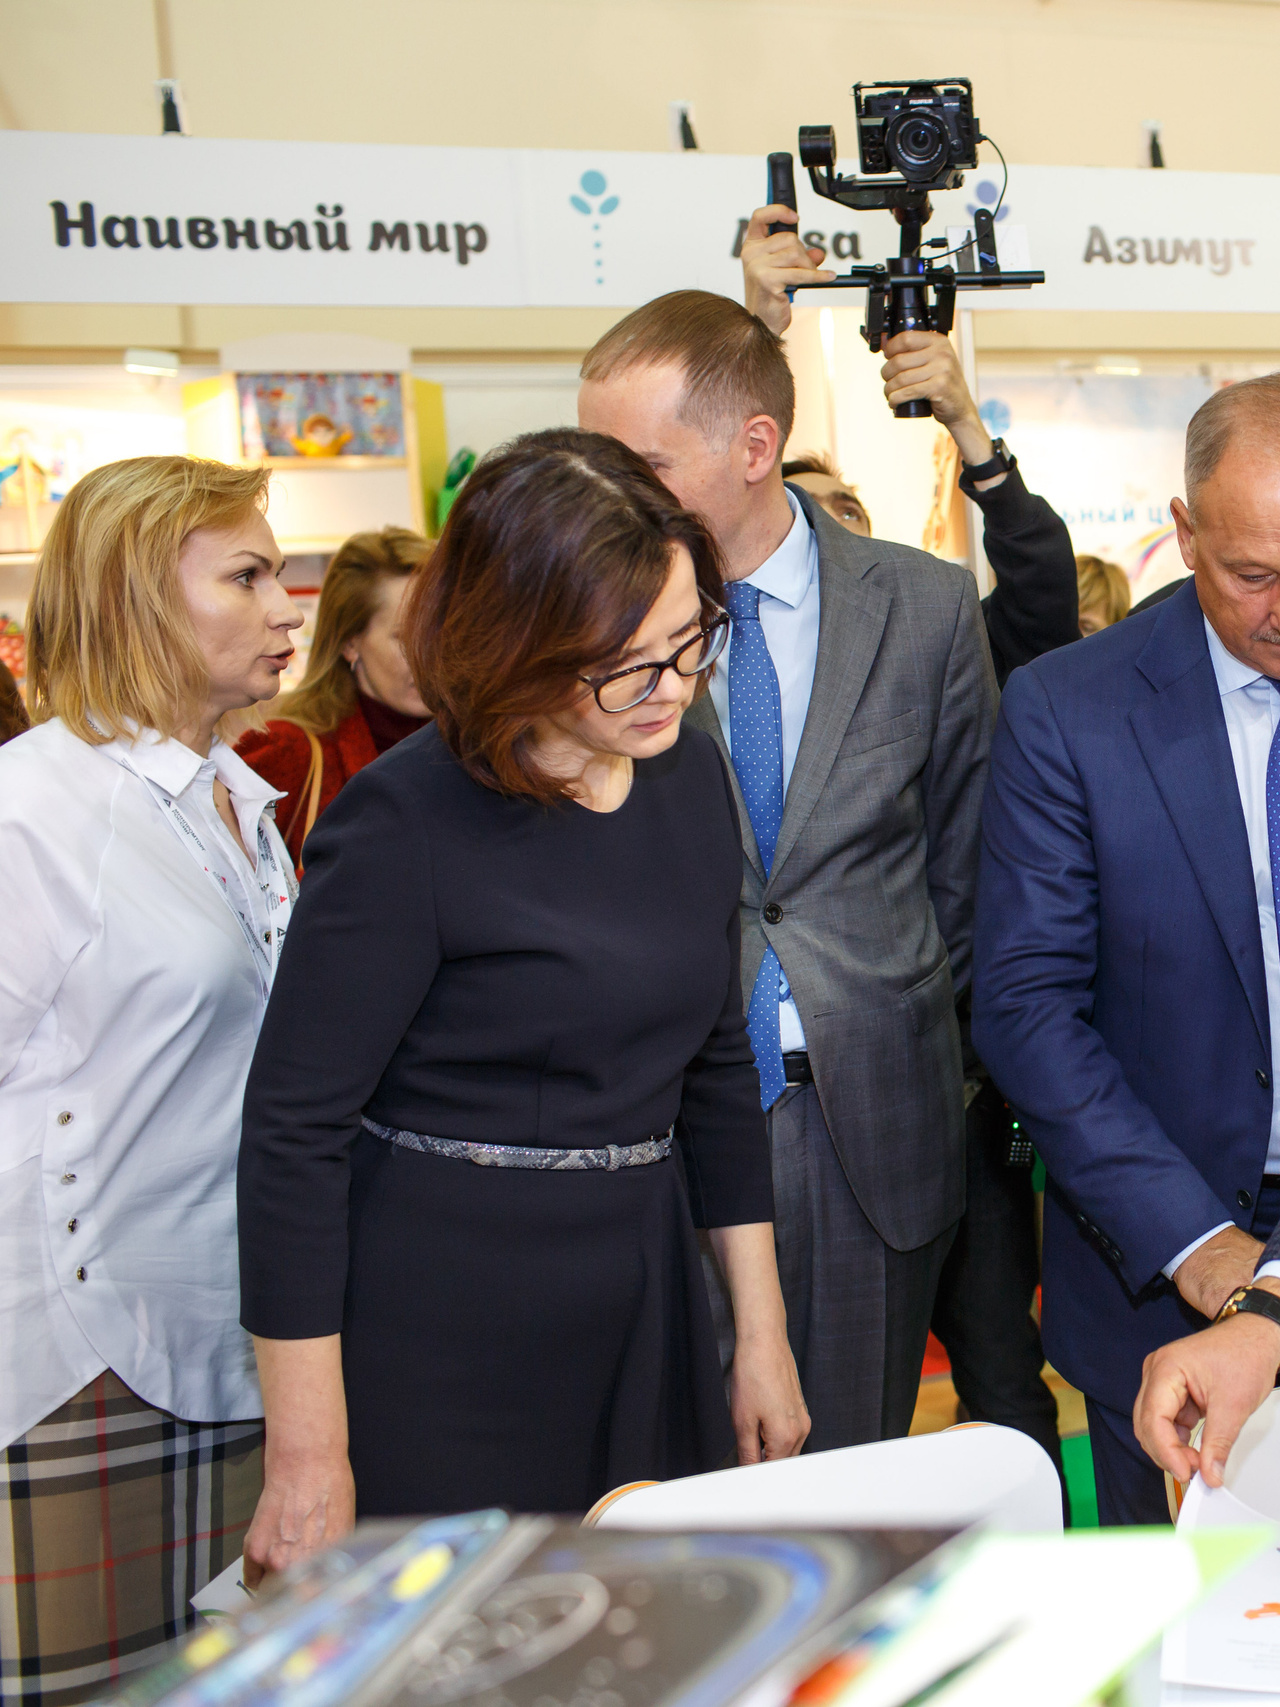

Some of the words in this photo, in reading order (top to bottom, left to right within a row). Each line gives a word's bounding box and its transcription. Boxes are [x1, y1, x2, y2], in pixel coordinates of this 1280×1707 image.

[49, 200, 351, 252] Наивный
[367, 220, 488, 266] мир
[1083, 225, 1257, 276] Азимут
